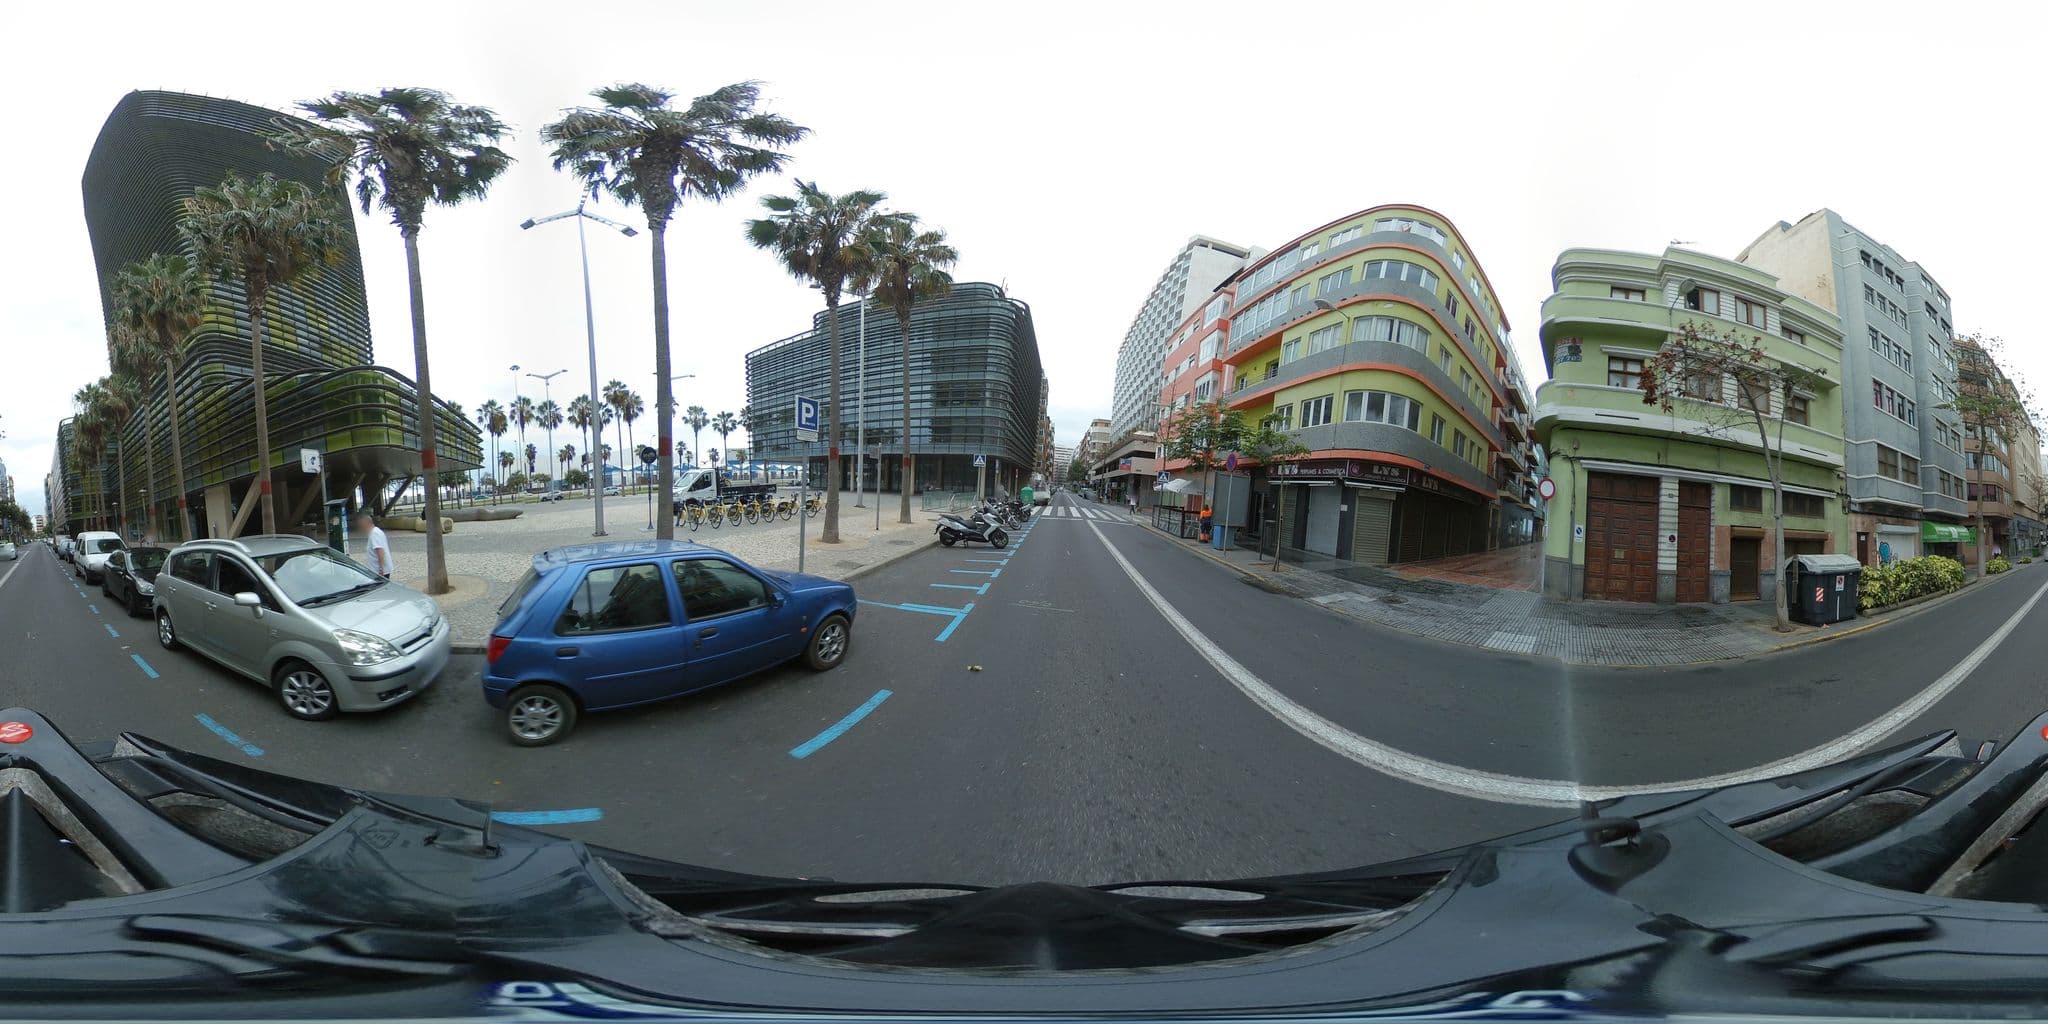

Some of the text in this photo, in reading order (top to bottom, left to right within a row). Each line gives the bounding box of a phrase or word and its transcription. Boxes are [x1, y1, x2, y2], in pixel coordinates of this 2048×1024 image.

[801, 402, 815, 425] P
[1373, 465, 1400, 477] LYS
[1422, 476, 1439, 490] LYS
